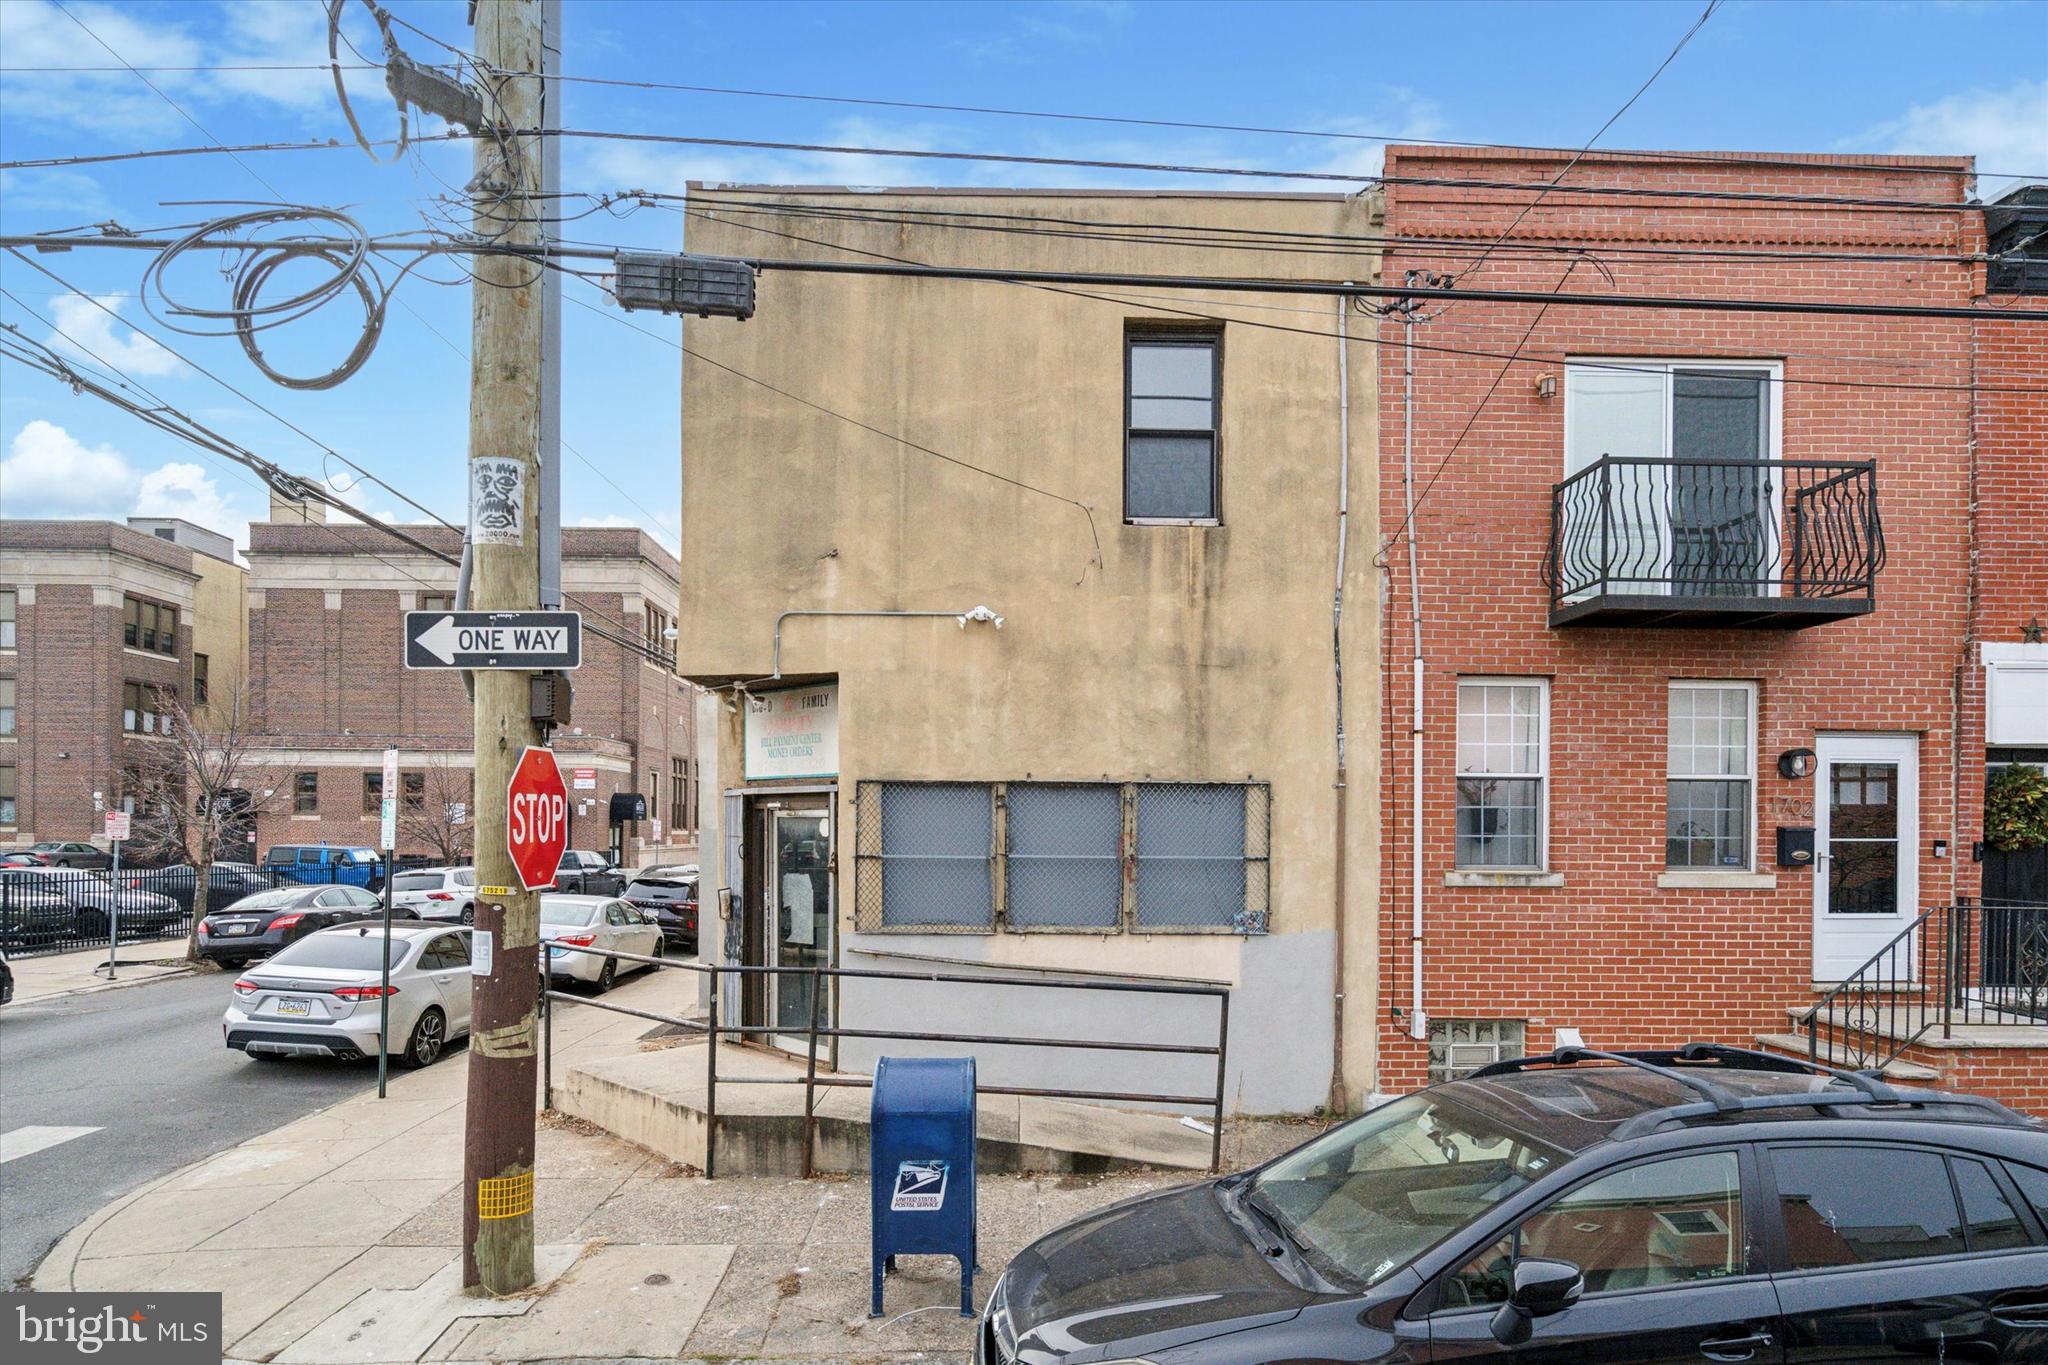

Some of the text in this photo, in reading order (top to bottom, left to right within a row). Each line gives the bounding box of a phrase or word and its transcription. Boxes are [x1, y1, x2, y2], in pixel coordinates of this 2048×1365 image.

[458, 629, 561, 650] ONE WAY
[802, 693, 829, 709] FAMILY
[760, 733, 822, 748] BILL PAYMENT CENTER
[767, 745, 814, 759] MONEY ORDERS
[1770, 796, 1813, 817] 1702
[512, 792, 564, 845] STOP
